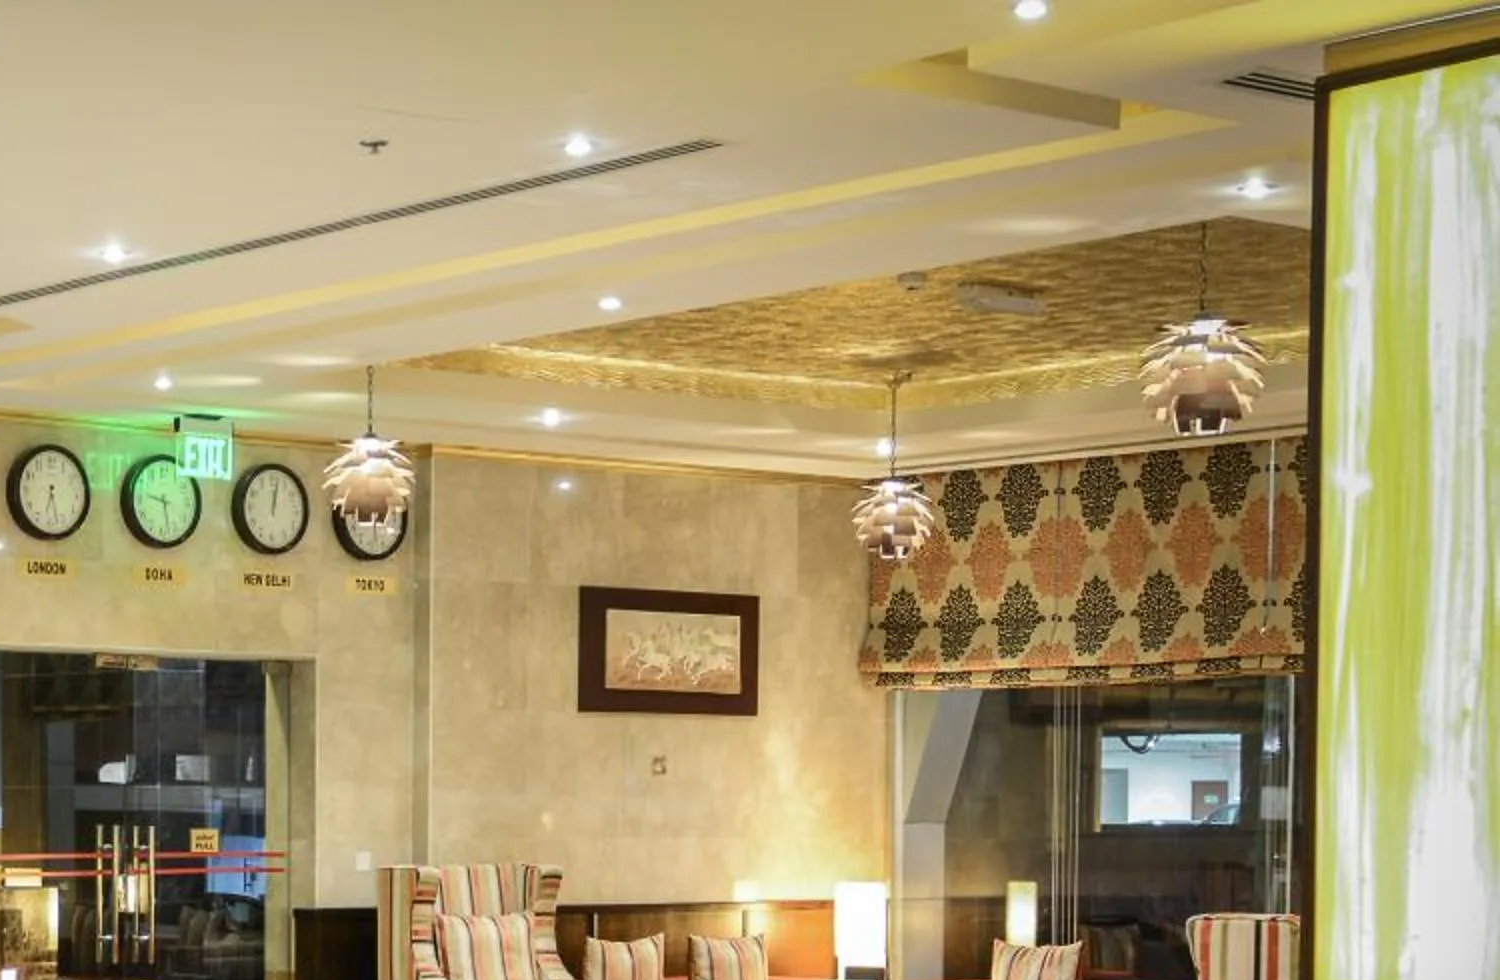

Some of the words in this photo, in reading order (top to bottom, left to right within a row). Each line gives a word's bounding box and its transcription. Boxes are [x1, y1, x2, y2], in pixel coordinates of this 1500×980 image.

[184, 436, 226, 477] EXIT
[27, 561, 67, 574] LONDON
[145, 567, 173, 580] DOHA
[243, 573, 263, 585] NEW
[265, 573, 291, 587] DELHI
[355, 578, 385, 592] TOKYO
